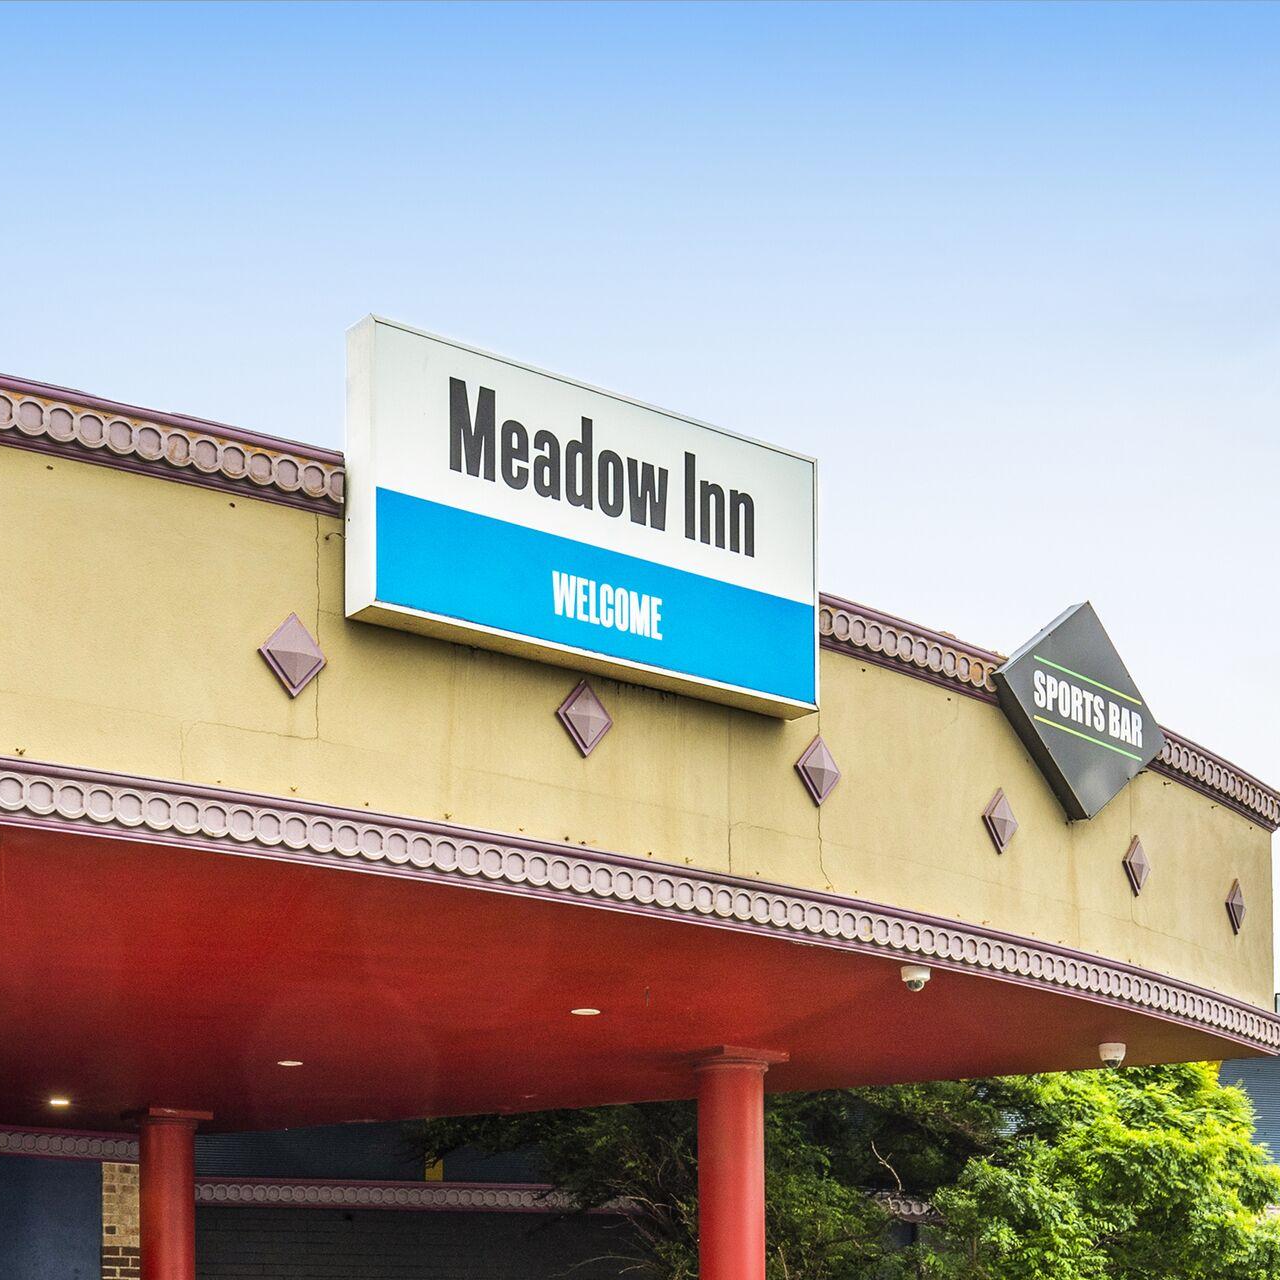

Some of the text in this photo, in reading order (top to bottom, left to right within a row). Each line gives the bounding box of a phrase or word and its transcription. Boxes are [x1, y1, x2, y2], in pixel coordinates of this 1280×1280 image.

[449, 376, 756, 559] Meadow Inn
[551, 569, 664, 642] WELCOME
[1033, 669, 1143, 749] SPORTS BAR
